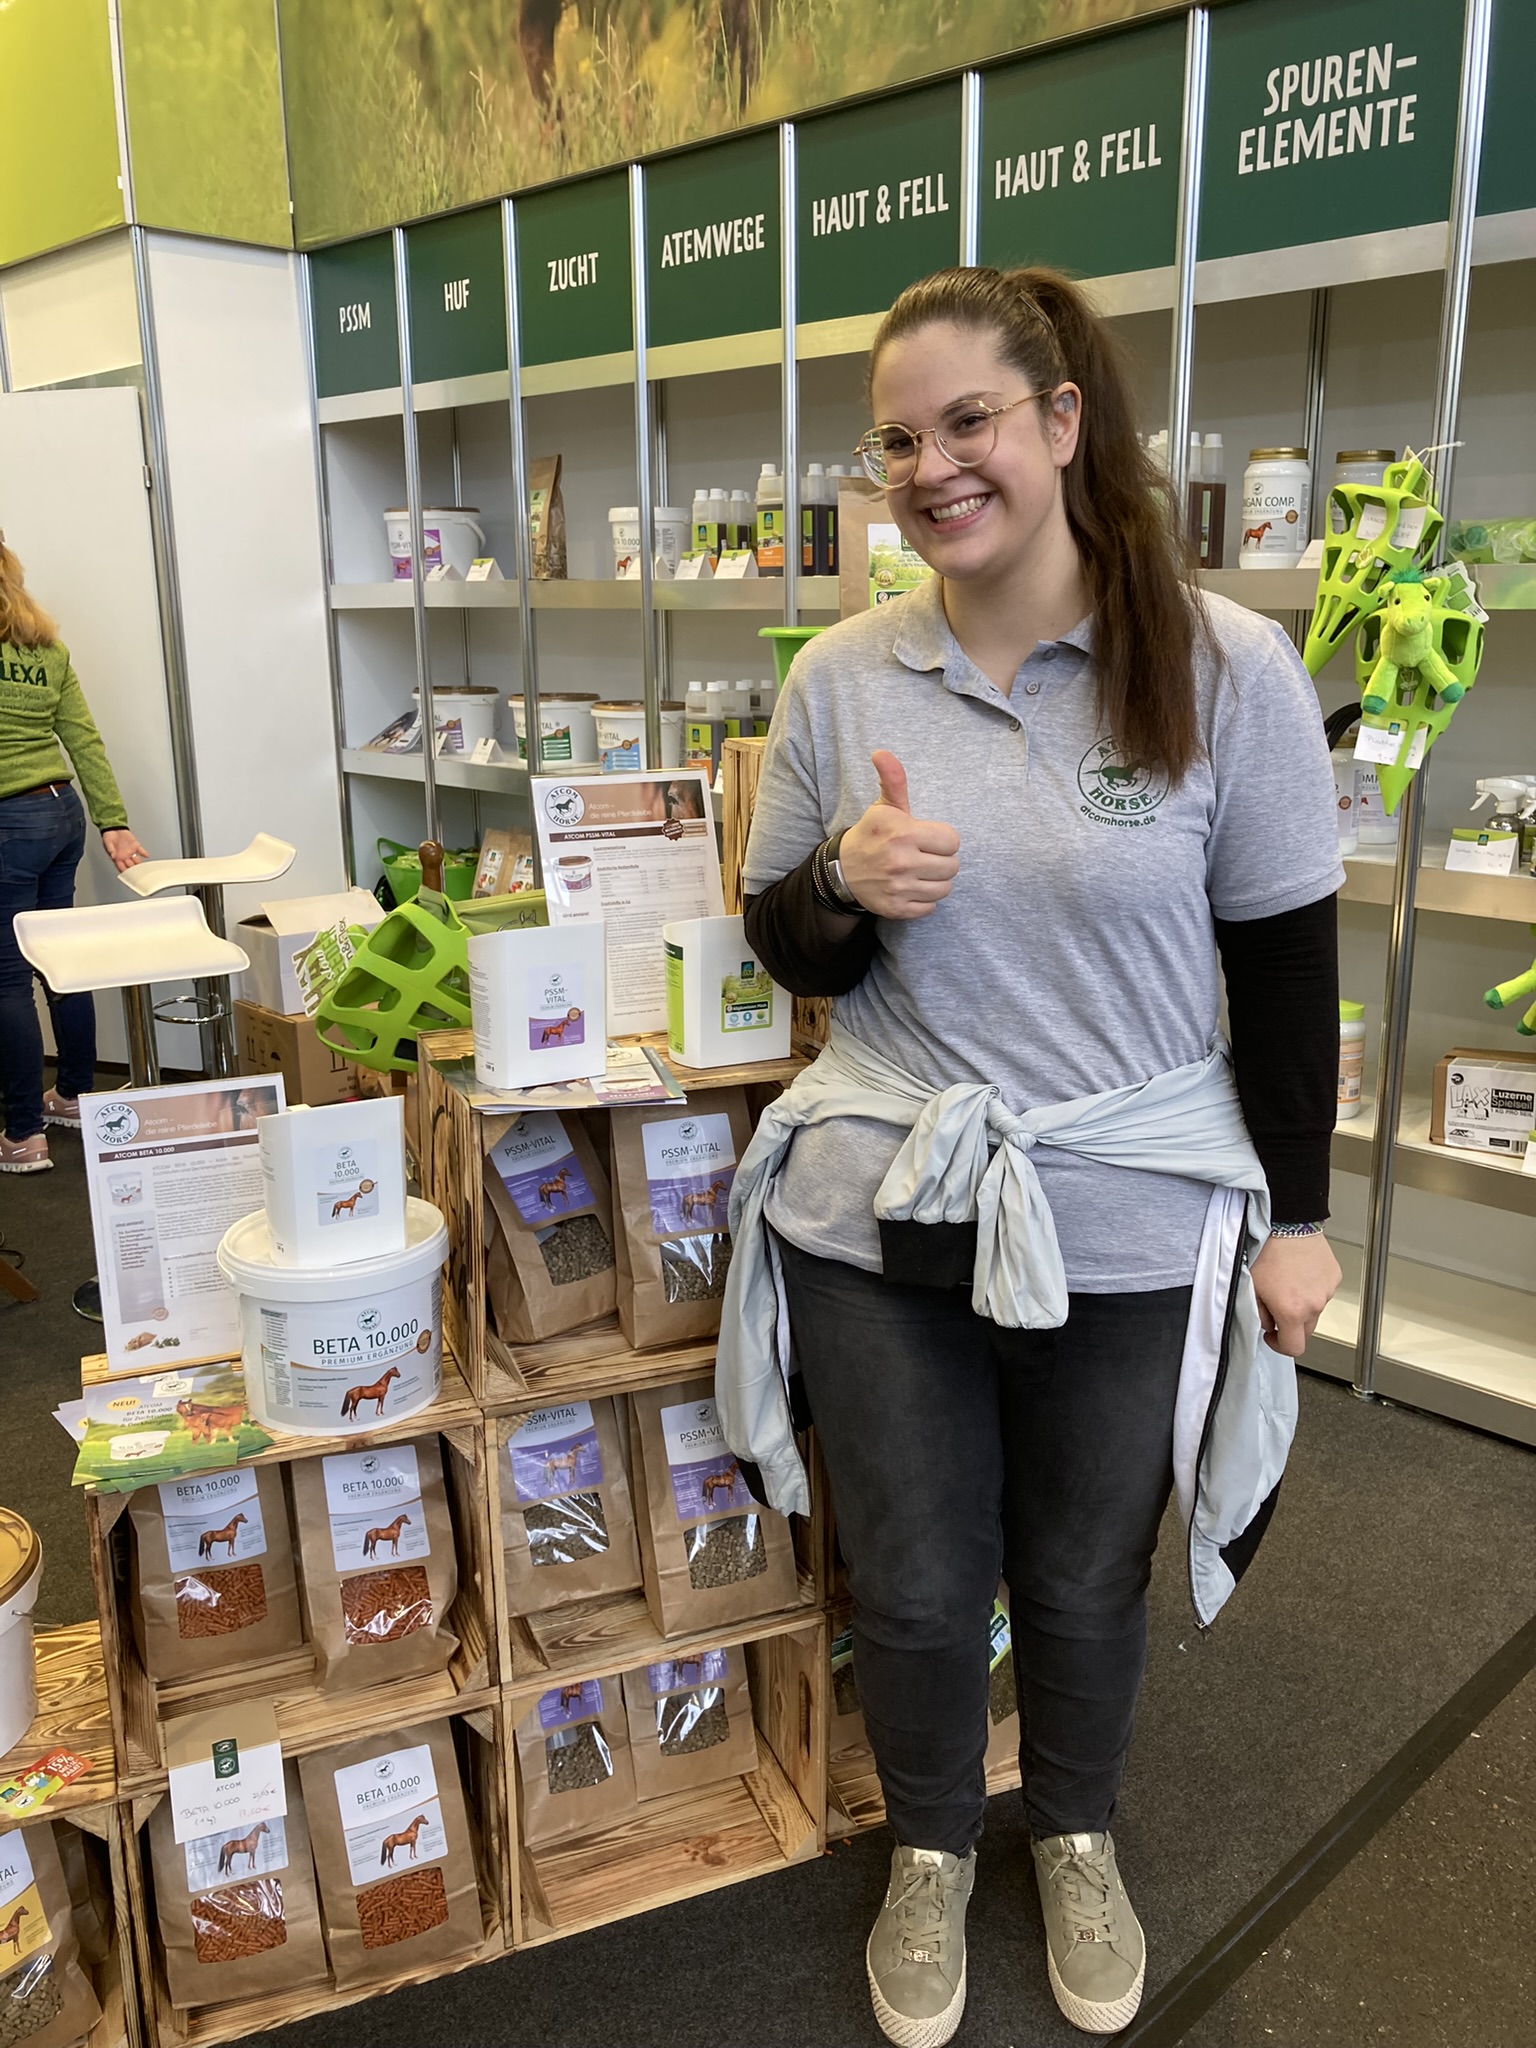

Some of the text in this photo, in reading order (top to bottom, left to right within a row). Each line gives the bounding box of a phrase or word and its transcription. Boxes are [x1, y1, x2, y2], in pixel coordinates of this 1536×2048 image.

[1263, 42, 1418, 117] SPUREN-
[1237, 95, 1418, 175] ELEMENTE
[994, 124, 1162, 200] HAUT & FELL
[811, 172, 949, 237] HAUT & FELL
[660, 214, 766, 268] ATEMWEGE
[547, 251, 599, 292] ZUCHT
[443, 278, 471, 312] HUF
[338, 302, 371, 334] PSSM
[1264, 496, 1295, 507] COMP.
[0, 660, 48, 687] LEXA
[550, 788, 579, 800] ATCOM
[1088, 786, 1153, 811] HORSE
[553, 814, 580, 825] HORSE
[1080, 805, 1156, 828] atcomhorse.de
[585, 831, 616, 839] PSSM-VITAL
[546, 995, 566, 1004] VITAL
[1449, 1085, 1490, 1109] LAX
[1491, 1097, 1533, 1111] Spielseil
[1492, 1089, 1533, 1102] Luzerne
[100, 1105, 133, 1118] ATCOM
[144, 1118, 169, 1126] Atcom
[102, 1131, 135, 1144] HORSE
[504, 1135, 557, 1158] PSSM-VITAL
[114, 1146, 175, 1160] ATCOM BETA 10.000
[661, 1142, 721, 1159] PSSM-VITAL
[333, 1167, 360, 1178] 10.000
[336, 1160, 357, 1170] BETA
[313, 1318, 419, 1355] BETA 10.000
[321, 1355, 363, 1366] PREMIUM
[112, 1399, 136, 1408] NEU!
[526, 1407, 578, 1427] SSM-VITAL
[679, 1425, 723, 1443] PSSM-VI
[176, 1474, 241, 1497] BETA 10.000
[342, 1475, 405, 1494] BETA 10.000
[47, 1754, 75, 1772] 15%
[216, 1781, 242, 1793] ATCOM
[356, 1775, 421, 1805] BETA 10.000
[180, 1805, 210, 1819] BETA
[0, 1866, 19, 1882] TAL
